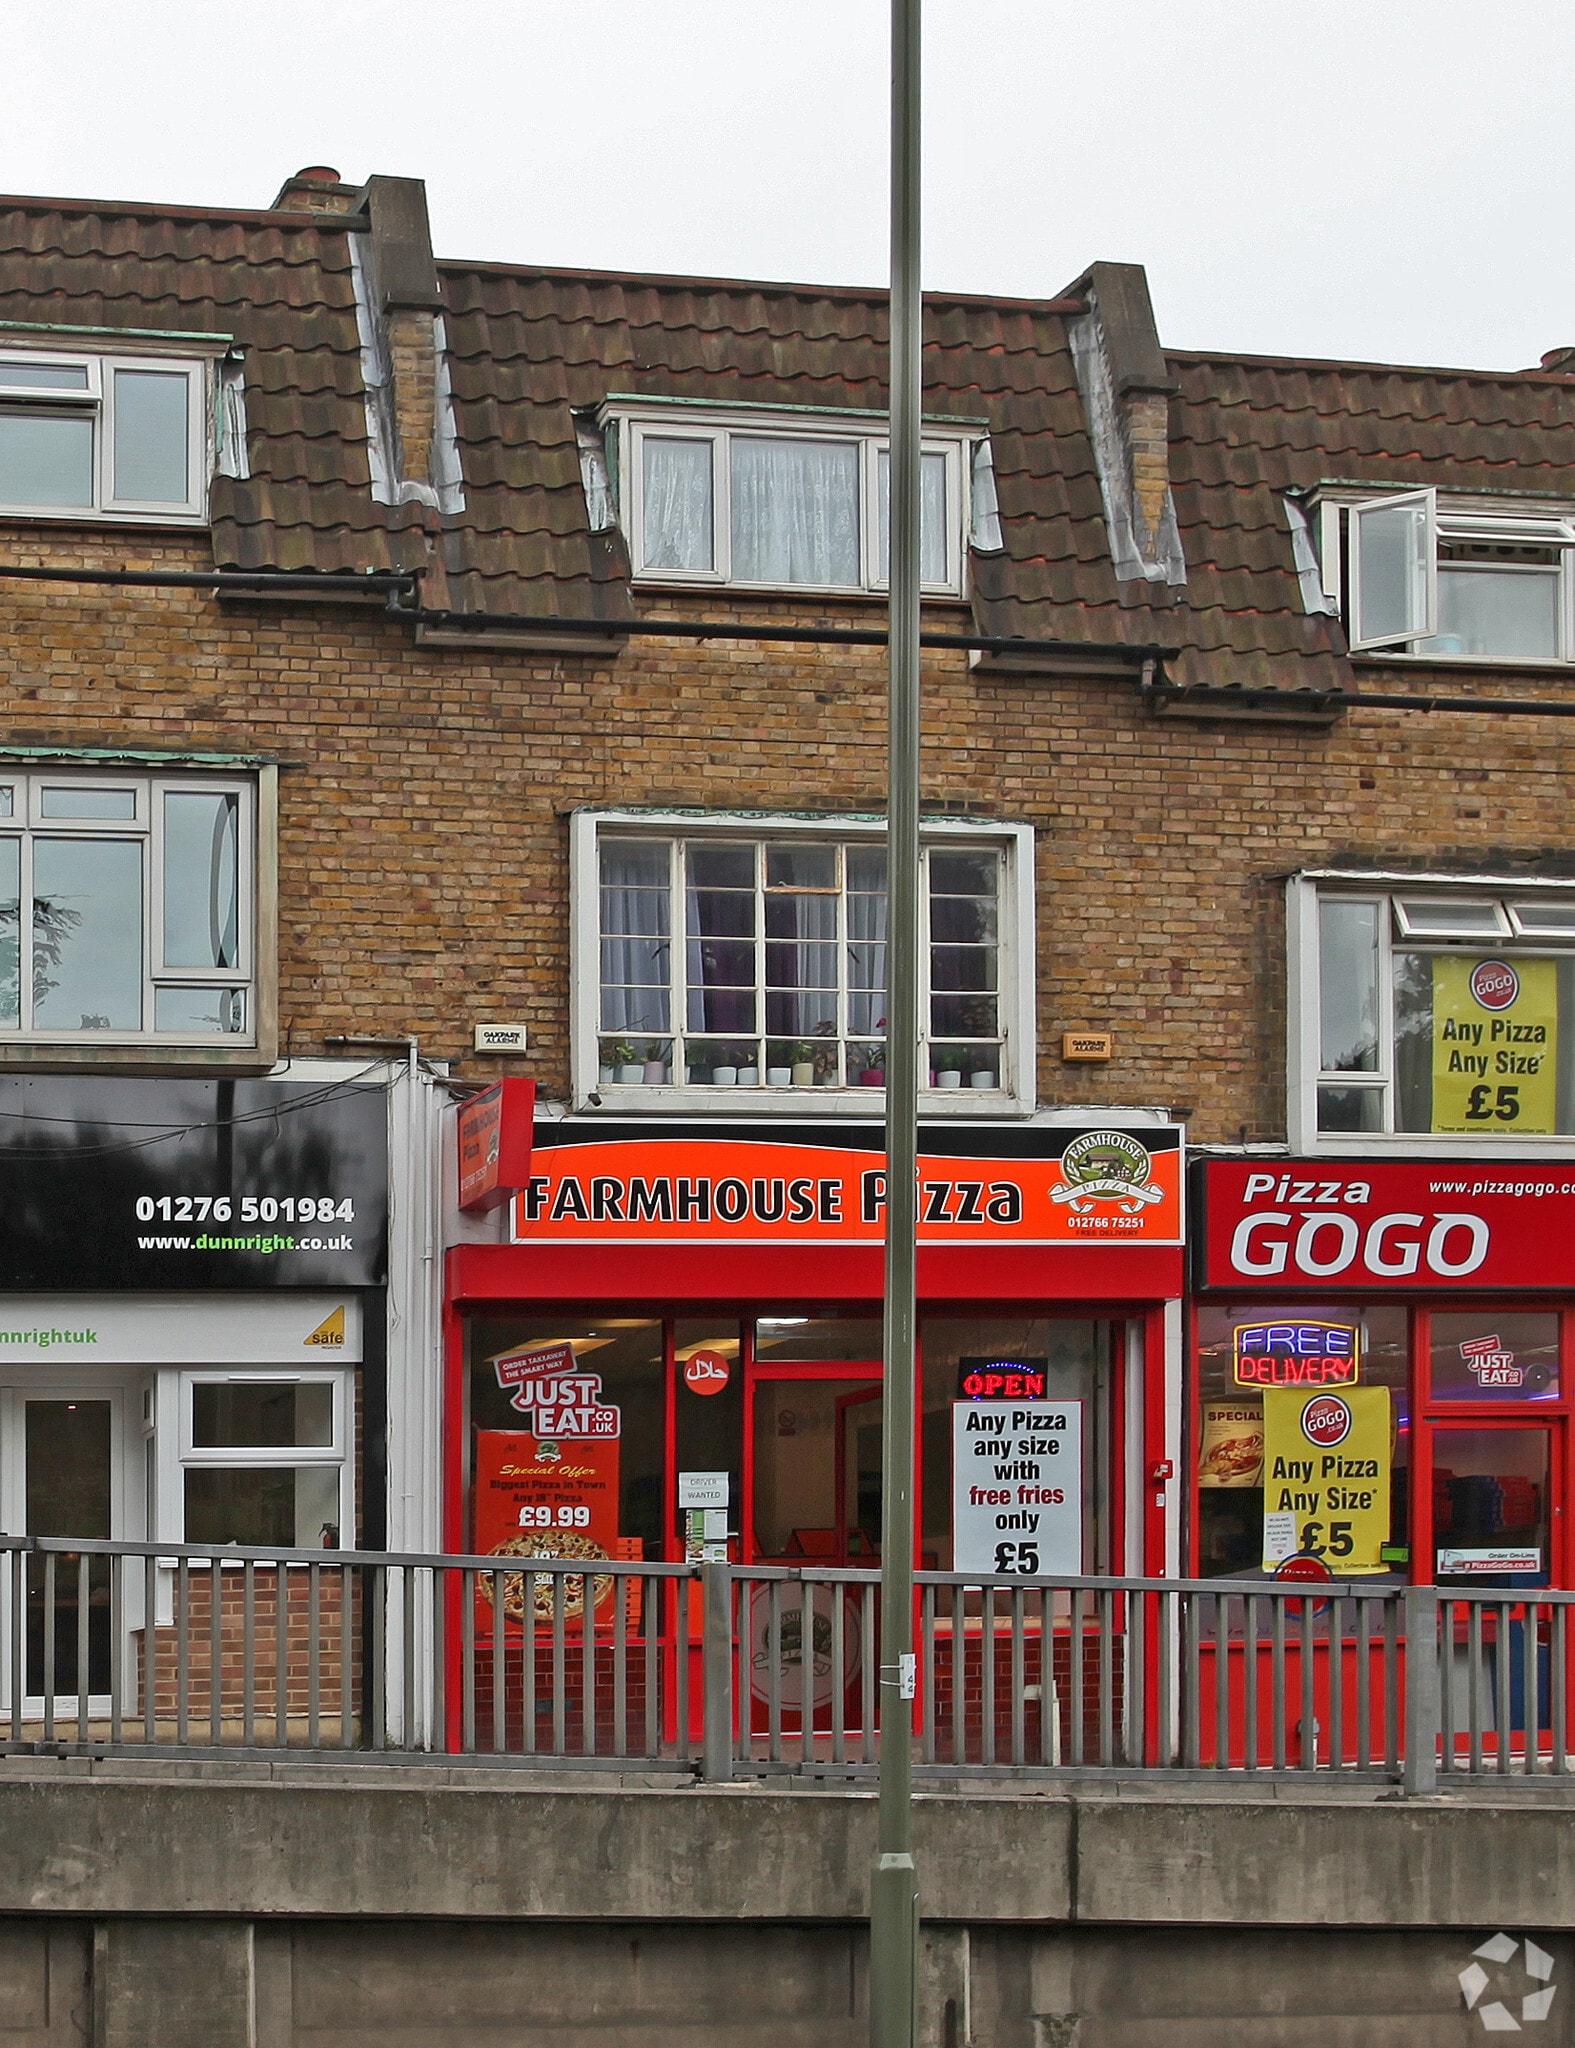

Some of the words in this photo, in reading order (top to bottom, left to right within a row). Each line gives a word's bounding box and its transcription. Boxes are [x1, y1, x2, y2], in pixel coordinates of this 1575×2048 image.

[1476, 974, 1514, 997] GOGO
[1442, 1018, 1483, 1046] Any
[1490, 1019, 1546, 1044] Pizza
[1448, 1050, 1489, 1078] Any
[1465, 1084, 1520, 1121] £5
[1068, 1133, 1144, 1160] FARMHOUSE
[1081, 1179, 1130, 1192] PIZZA
[1243, 1173, 1372, 1204] Pizza
[135, 1196, 232, 1222] 01276
[240, 1197, 355, 1223] 501984
[525, 1175, 843, 1223] FARMHOUSE
[1067, 1217, 1109, 1228] 012766
[1111, 1217, 1145, 1228] 75251
[1099, 1229, 1138, 1237] DELIVERY
[137, 1233, 353, 1254] www.dunnright.co.uk
[1230, 1211, 1490, 1277] GOGO
[312, 1331, 343, 1344] safe
[1241, 1325, 1351, 1355] FREE
[502, 1359, 528, 1371] ORDER
[528, 1350, 567, 1364] TAKEAWAY
[504, 1371, 520, 1379] THE
[520, 1364, 545, 1376] SMART
[546, 1360, 564, 1369] WAY
[1240, 1356, 1354, 1384] DELIVERY
[1471, 1354, 1510, 1369] JUST
[963, 1373, 1046, 1396] OPEN
[1481, 1369, 1510, 1383] EAT
[519, 1379, 596, 1406] JUST
[538, 1408, 596, 1433] EAT
[966, 1411, 1006, 1435] Any
[1012, 1411, 1067, 1431] Pizza
[1307, 1409, 1345, 1432] GOGO
[974, 1439, 1012, 1459] any
[1017, 1435, 1060, 1455] size
[499, 1464, 556, 1477] Special
[559, 1465, 597, 1478] Offer
[994, 1460, 1040, 1480] with
[1272, 1456, 1314, 1483] Any
[1321, 1455, 1379, 1480] Pizza
[490, 1480, 529, 1490] Biggest
[532, 1480, 560, 1489] Pizza
[563, 1480, 574, 1489] in
[577, 1480, 606, 1489] Town
[690, 1478, 718, 1486] DRIVER
[513, 1493, 533, 1503] Any
[554, 1493, 583, 1502] Pizza
[687, 1491, 721, 1499] WANTED
[969, 1485, 1011, 1505] free
[1017, 1485, 1064, 1505] fries
[1278, 1488, 1320, 1515] Any
[519, 1505, 591, 1528] £9.99
[995, 1510, 1040, 1533] only
[1300, 1521, 1354, 1557] £5
[994, 1541, 1039, 1575] £5
